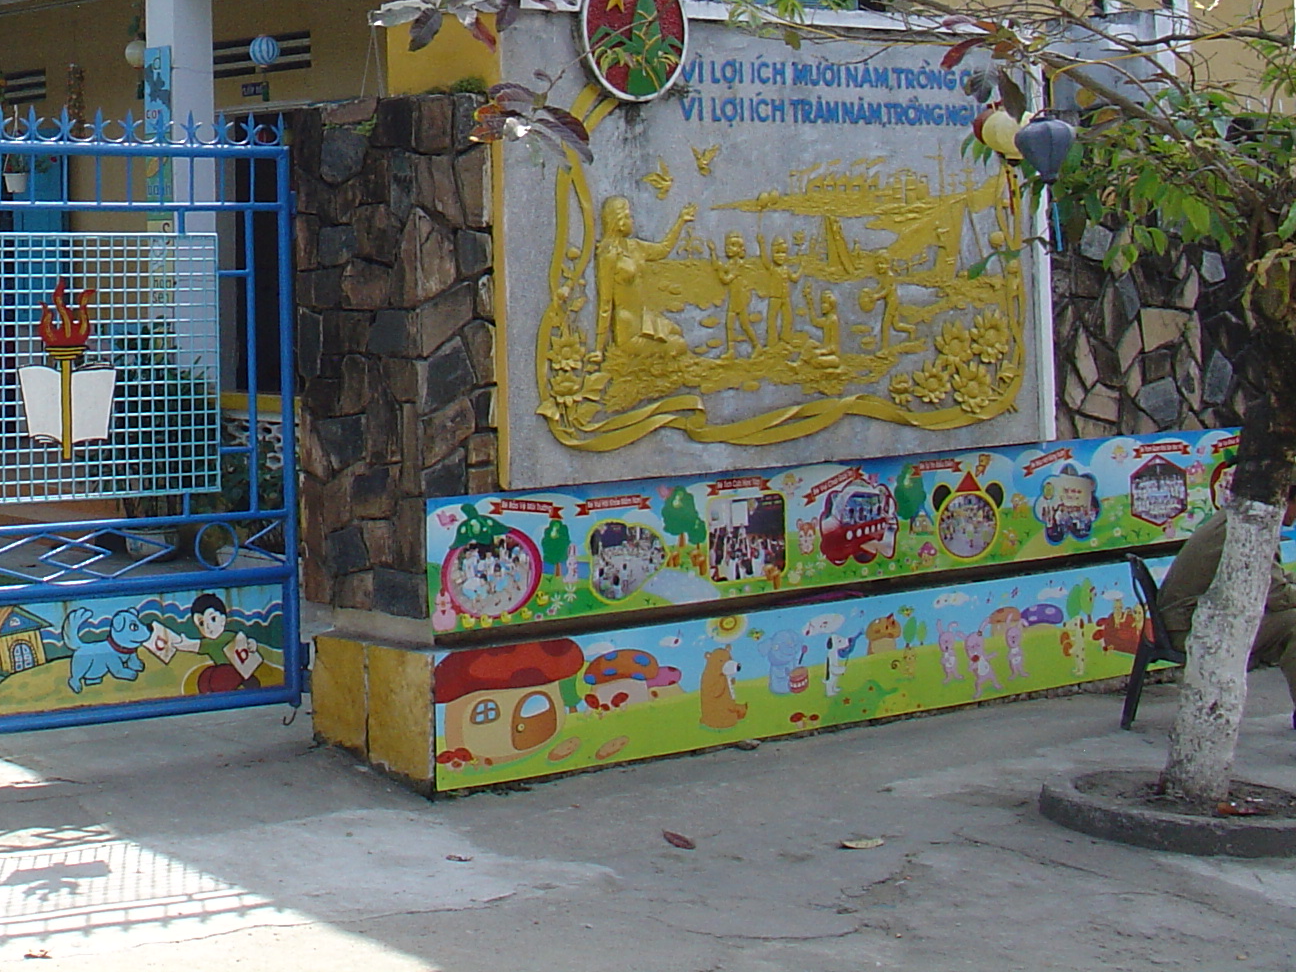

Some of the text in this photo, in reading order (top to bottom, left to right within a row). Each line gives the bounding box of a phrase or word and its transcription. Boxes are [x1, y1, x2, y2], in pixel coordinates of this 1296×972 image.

[681, 52, 704, 84] VÌ
[710, 58, 744, 90] LỢI
[750, 54, 786, 85] ÍCH
[679, 89, 704, 121] VÌ
[711, 97, 744, 127] LỢI
[750, 92, 786, 123] ÍCH
[234, 648, 250, 665] b
